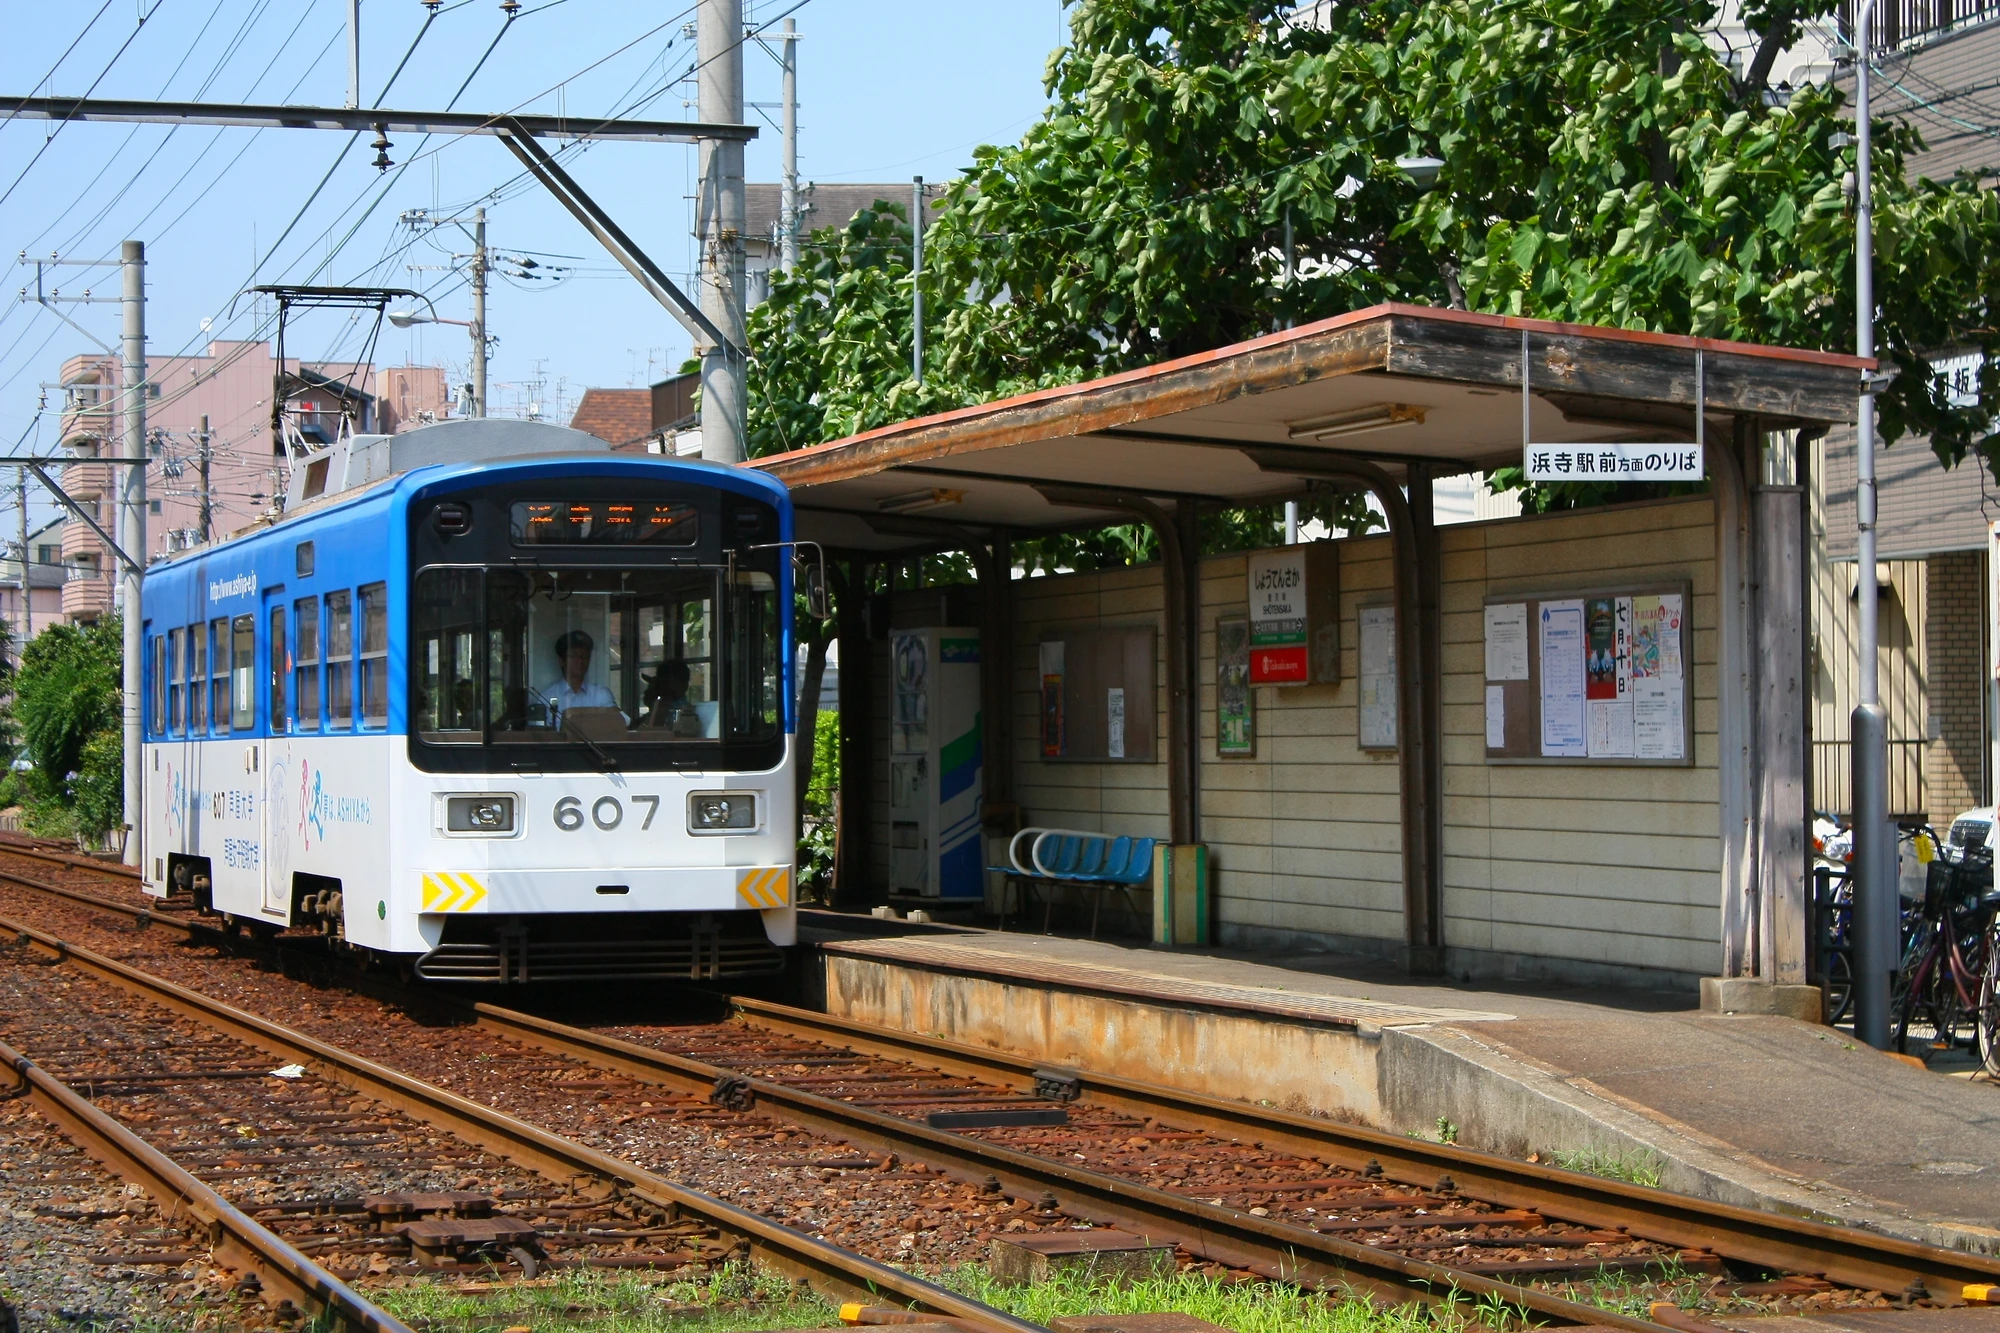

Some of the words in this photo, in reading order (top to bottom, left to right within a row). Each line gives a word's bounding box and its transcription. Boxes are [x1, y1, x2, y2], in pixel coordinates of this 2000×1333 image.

[1532, 451, 1697, 474] 浜寺駅前方面のりば
[1254, 567, 1300, 590] しょうてんさか
[1616, 601, 1627, 694] 七月十日
[213, 790, 226, 820] 607
[553, 795, 660, 831] 607
